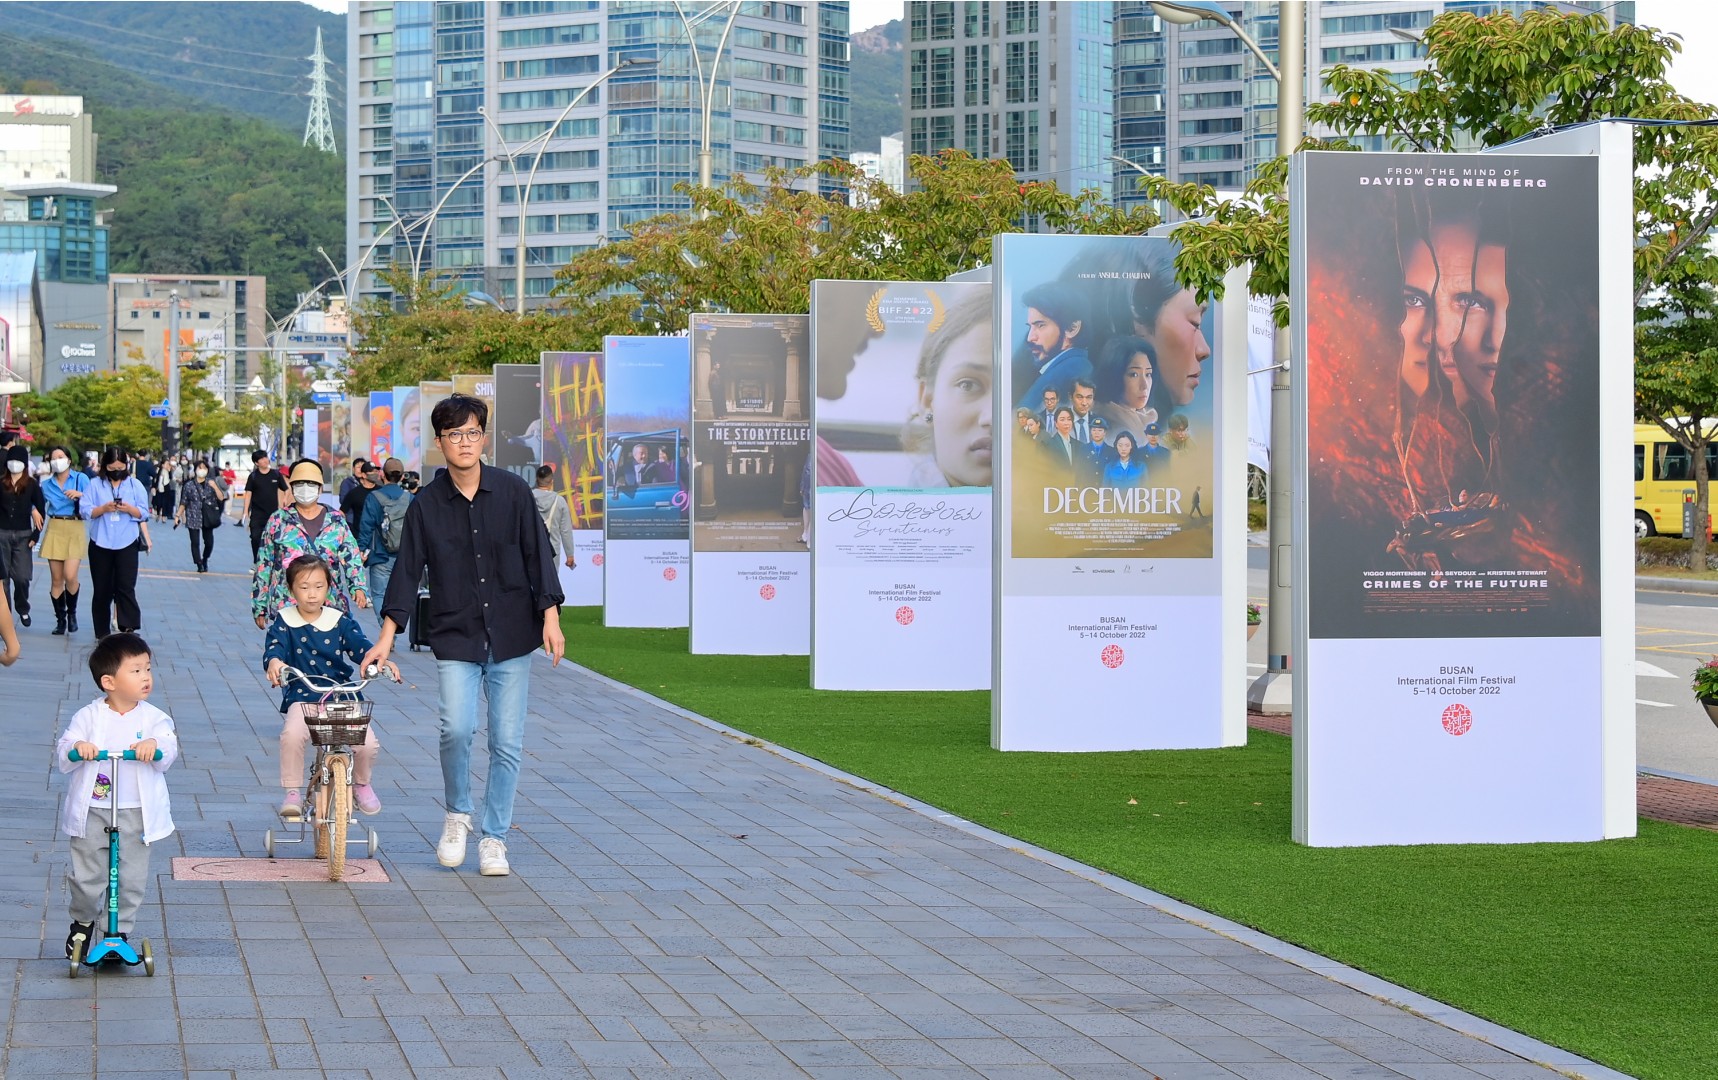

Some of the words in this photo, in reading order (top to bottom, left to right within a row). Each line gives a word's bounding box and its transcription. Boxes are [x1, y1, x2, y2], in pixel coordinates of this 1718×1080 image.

[1359, 177, 1414, 186] DAVID
[1424, 178, 1547, 188] CRONENBERG
[708, 428, 730, 440] THE
[1043, 487, 1182, 515] DECEMBER
[854, 520, 955, 538] Seventeeners
[1363, 580, 1422, 589] CRIMES
[1428, 580, 1448, 589] OF
[1454, 580, 1483, 588] THE
[1490, 580, 1548, 588] FUTURE
[1439, 666, 1474, 675] BUSAN
[1397, 676, 1456, 685] International
[1458, 676, 1479, 685] Film
[1480, 676, 1516, 685] Festival
[1439, 687, 1477, 695] October
[1478, 687, 1501, 695] 2022
